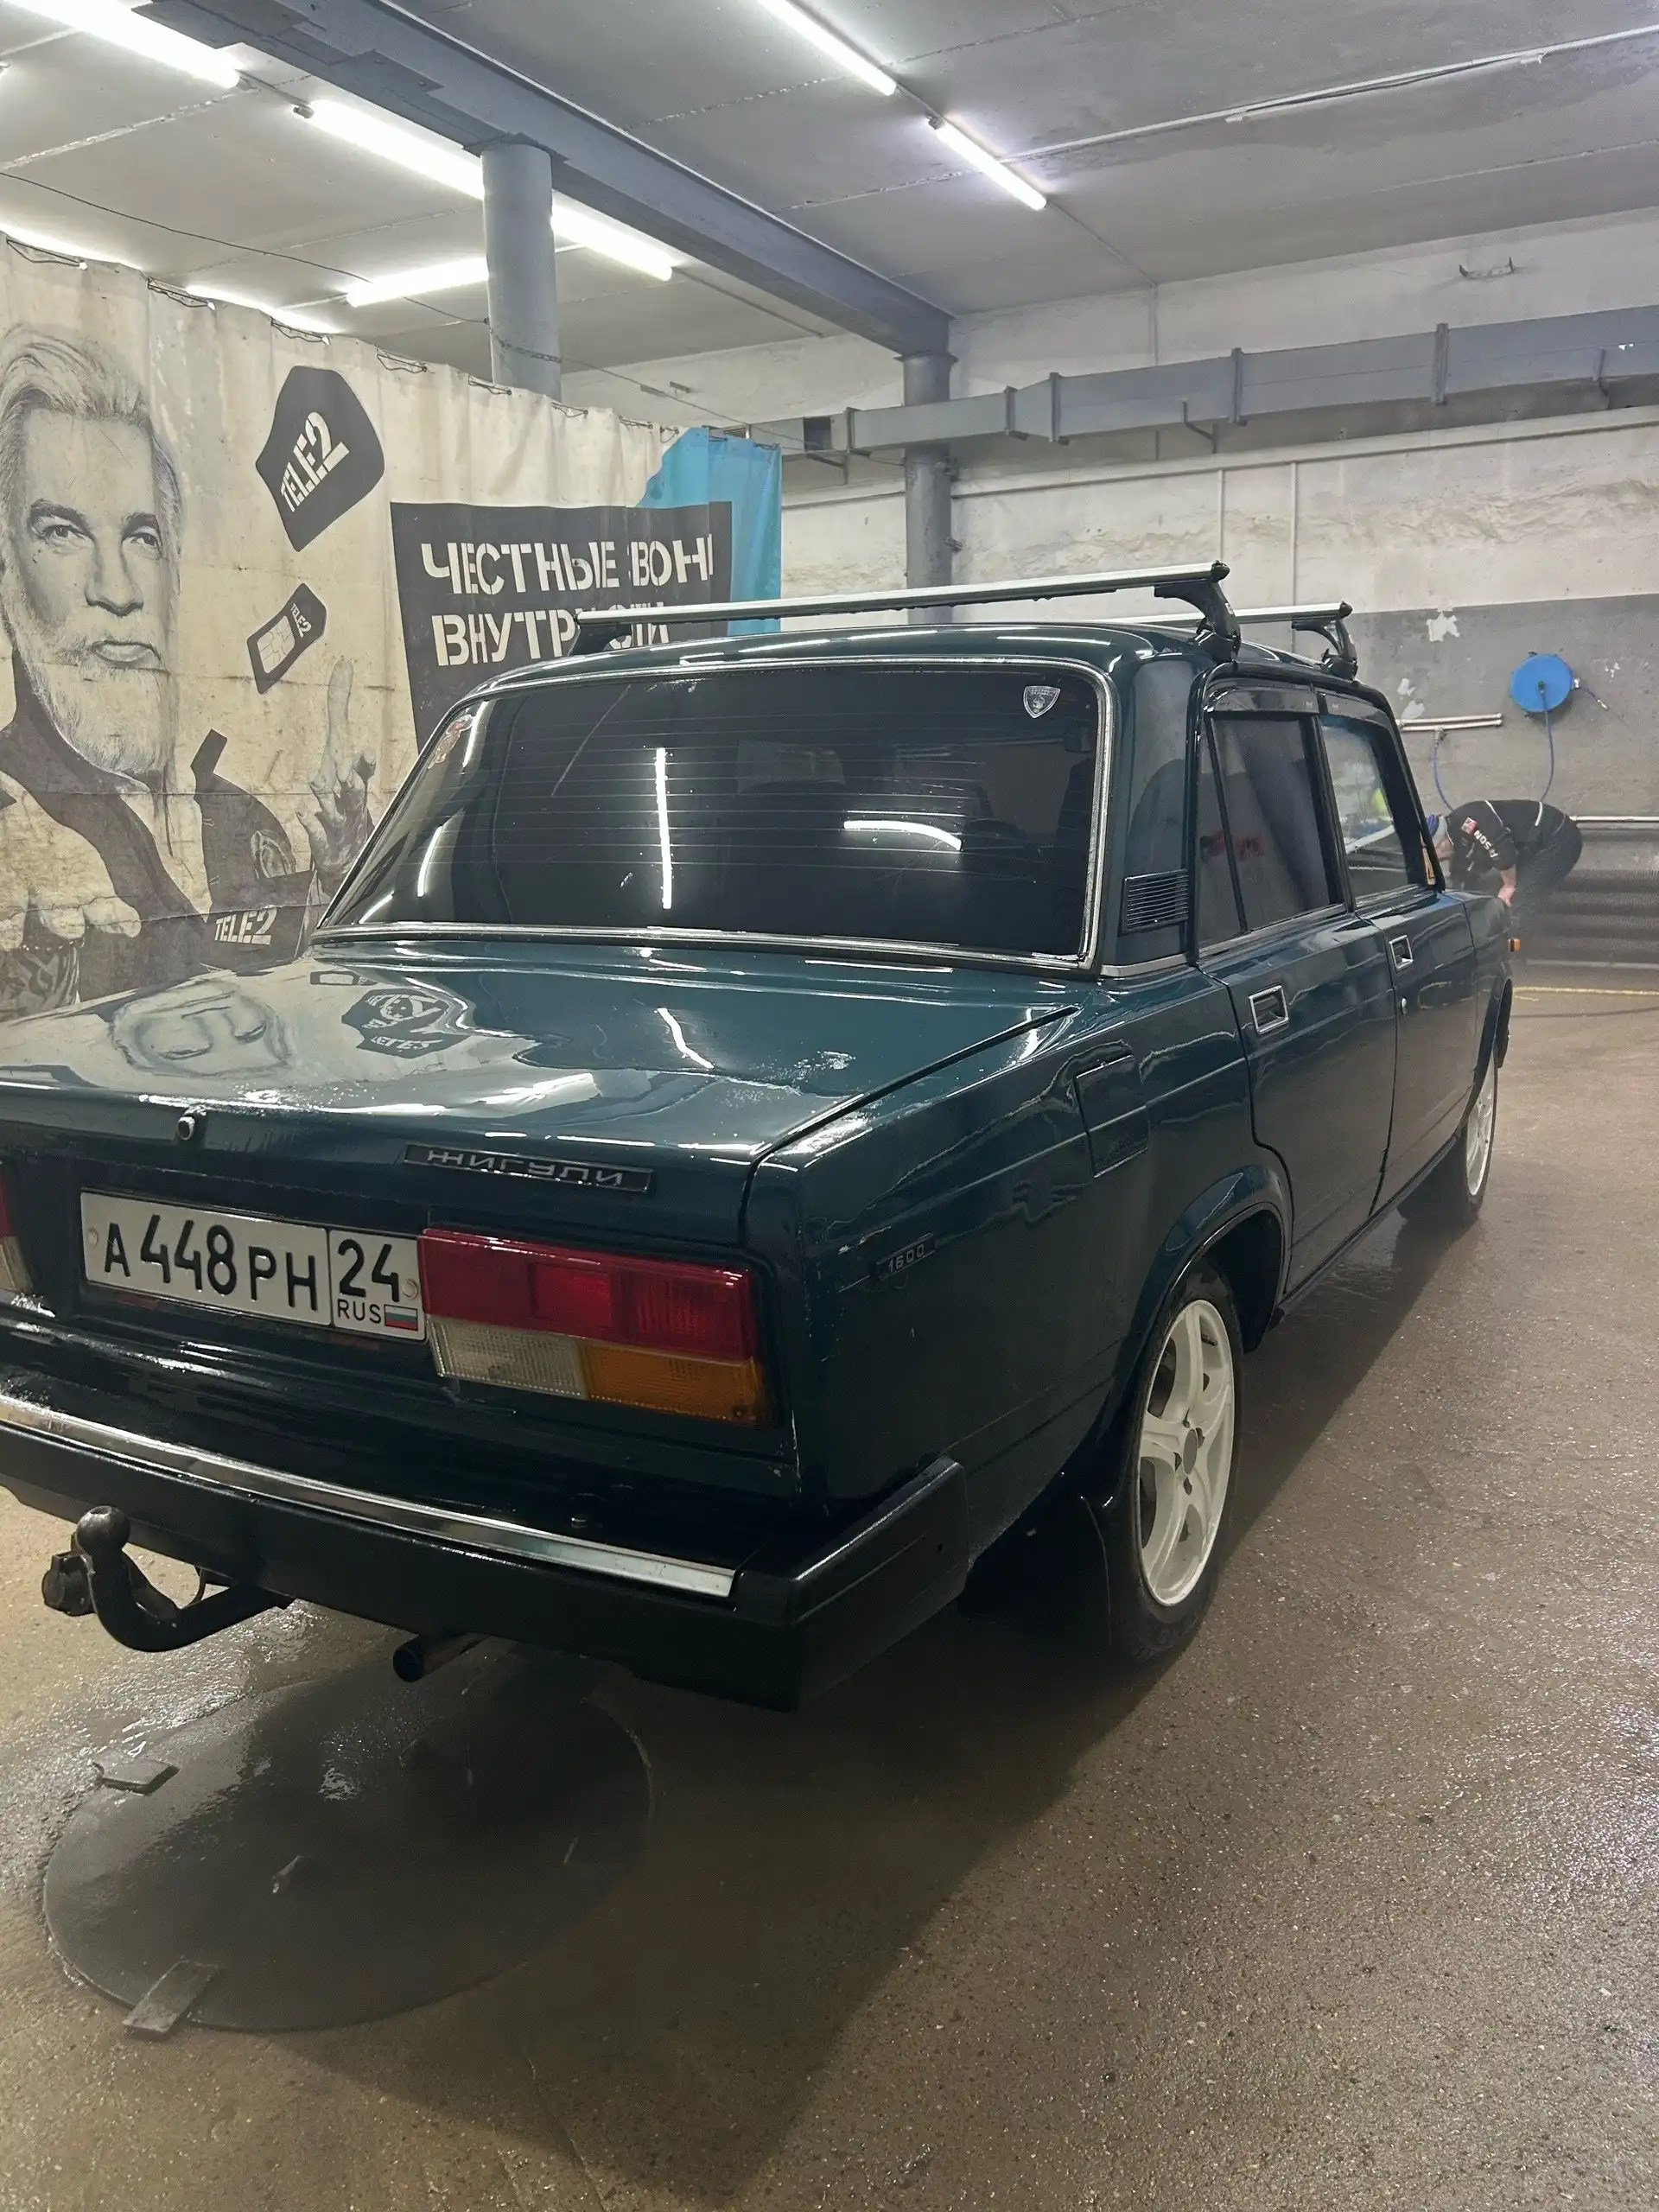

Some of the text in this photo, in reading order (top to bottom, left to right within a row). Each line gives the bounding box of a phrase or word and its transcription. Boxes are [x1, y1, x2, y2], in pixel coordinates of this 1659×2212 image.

[281, 412, 349, 512] TELE2
[421, 541, 620, 594] ЧЕСТНЫЕ
[290, 603, 312, 638] TELE2
[431, 607, 596, 666] ВНУТР
[214, 905, 277, 945] TELE2
[427, 1150, 623, 1186] ЖИГУЛИ
[338, 1238, 399, 1302] 24
[887, 1244, 925, 1273] 1600
[338, 1299, 381, 1324] RUS
